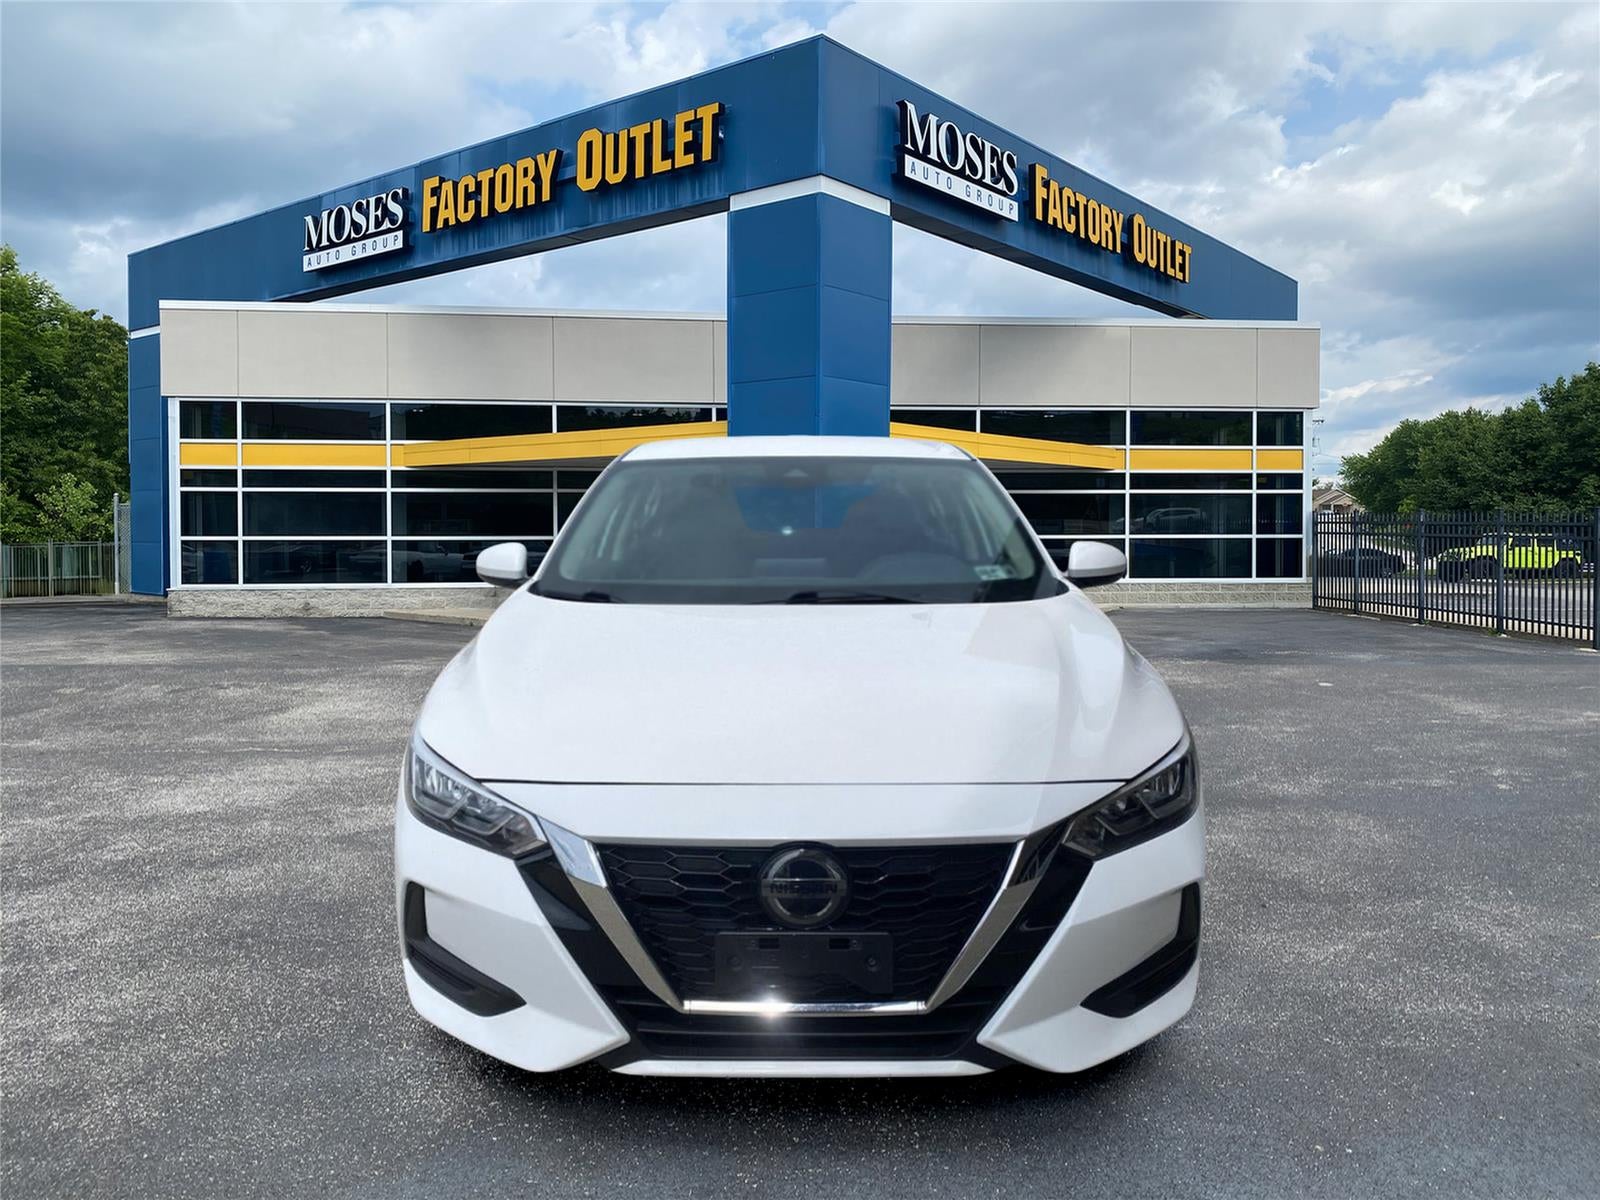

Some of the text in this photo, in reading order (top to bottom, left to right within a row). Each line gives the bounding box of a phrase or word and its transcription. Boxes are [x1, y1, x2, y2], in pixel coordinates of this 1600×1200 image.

[422, 102, 720, 232] FACTORY OUTLET
[903, 101, 1018, 196] MOSES
[910, 161, 1014, 214] AUTO GROUP
[303, 188, 403, 250] MOSES
[307, 234, 399, 268] AUTO GROUP
[1035, 163, 1191, 283] FACTORY OUTLET
